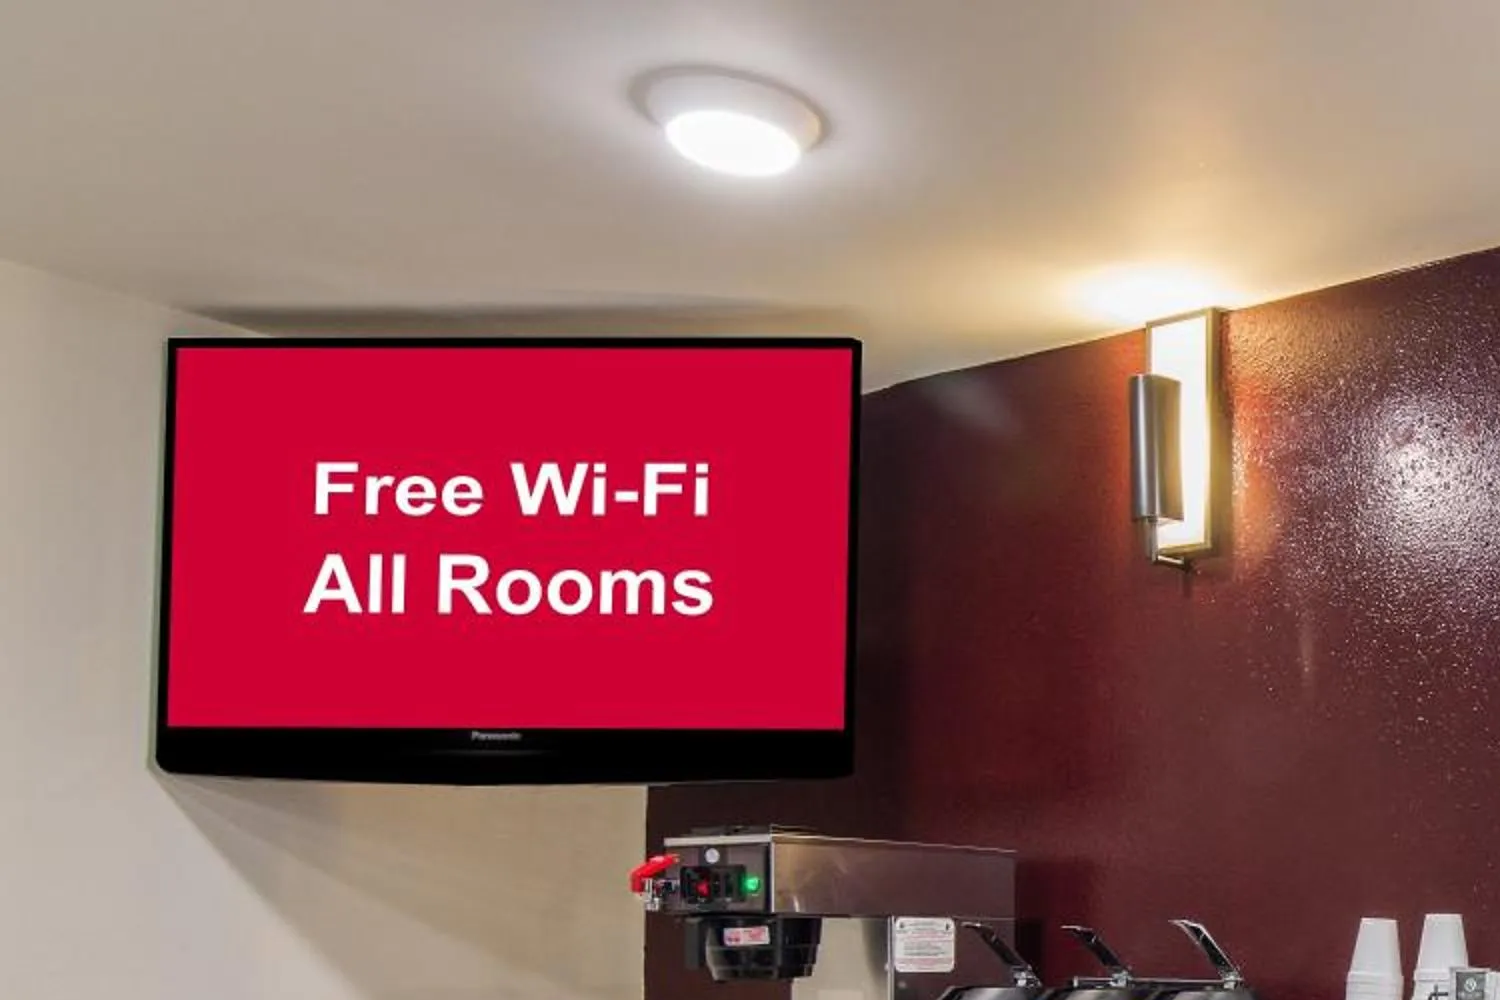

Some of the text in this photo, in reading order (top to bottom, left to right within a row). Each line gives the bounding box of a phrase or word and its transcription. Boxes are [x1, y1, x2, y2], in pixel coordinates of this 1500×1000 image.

[314, 461, 710, 517] Free Wi-Fi
[303, 553, 714, 616] All Rooms
